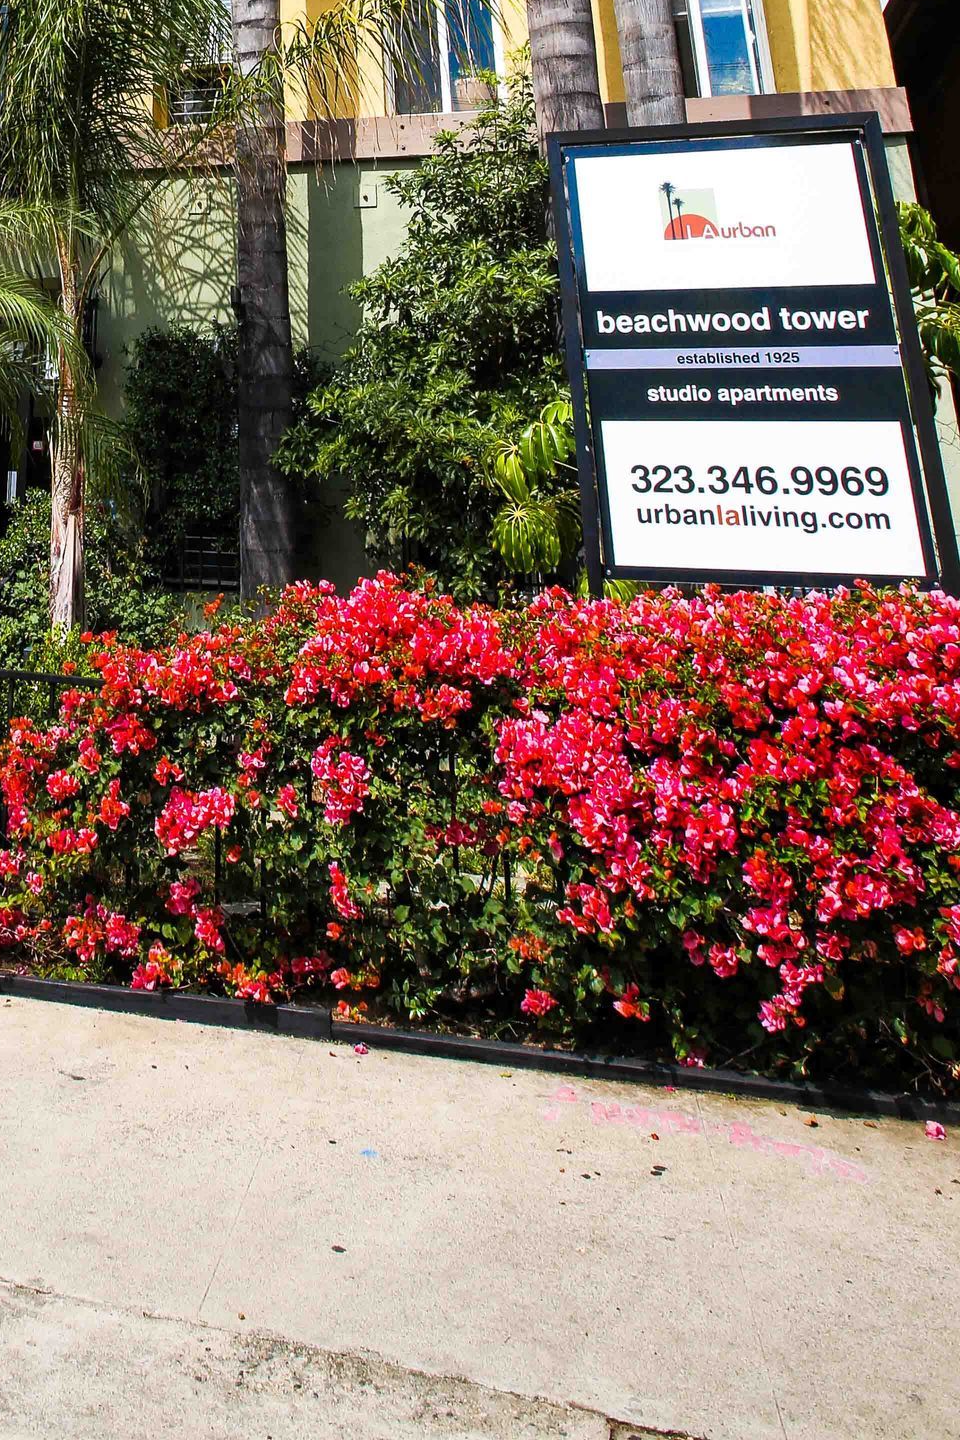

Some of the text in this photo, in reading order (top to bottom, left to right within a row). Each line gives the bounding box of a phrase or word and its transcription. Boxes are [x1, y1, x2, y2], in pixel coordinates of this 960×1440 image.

[596, 306, 870, 334] beachwood tower
[676, 351, 800, 365] established 1925
[646, 384, 839, 406] studio apartments
[630, 464, 890, 497] 323.346.9969
[636, 503, 892, 534] urbanlaliving.com
